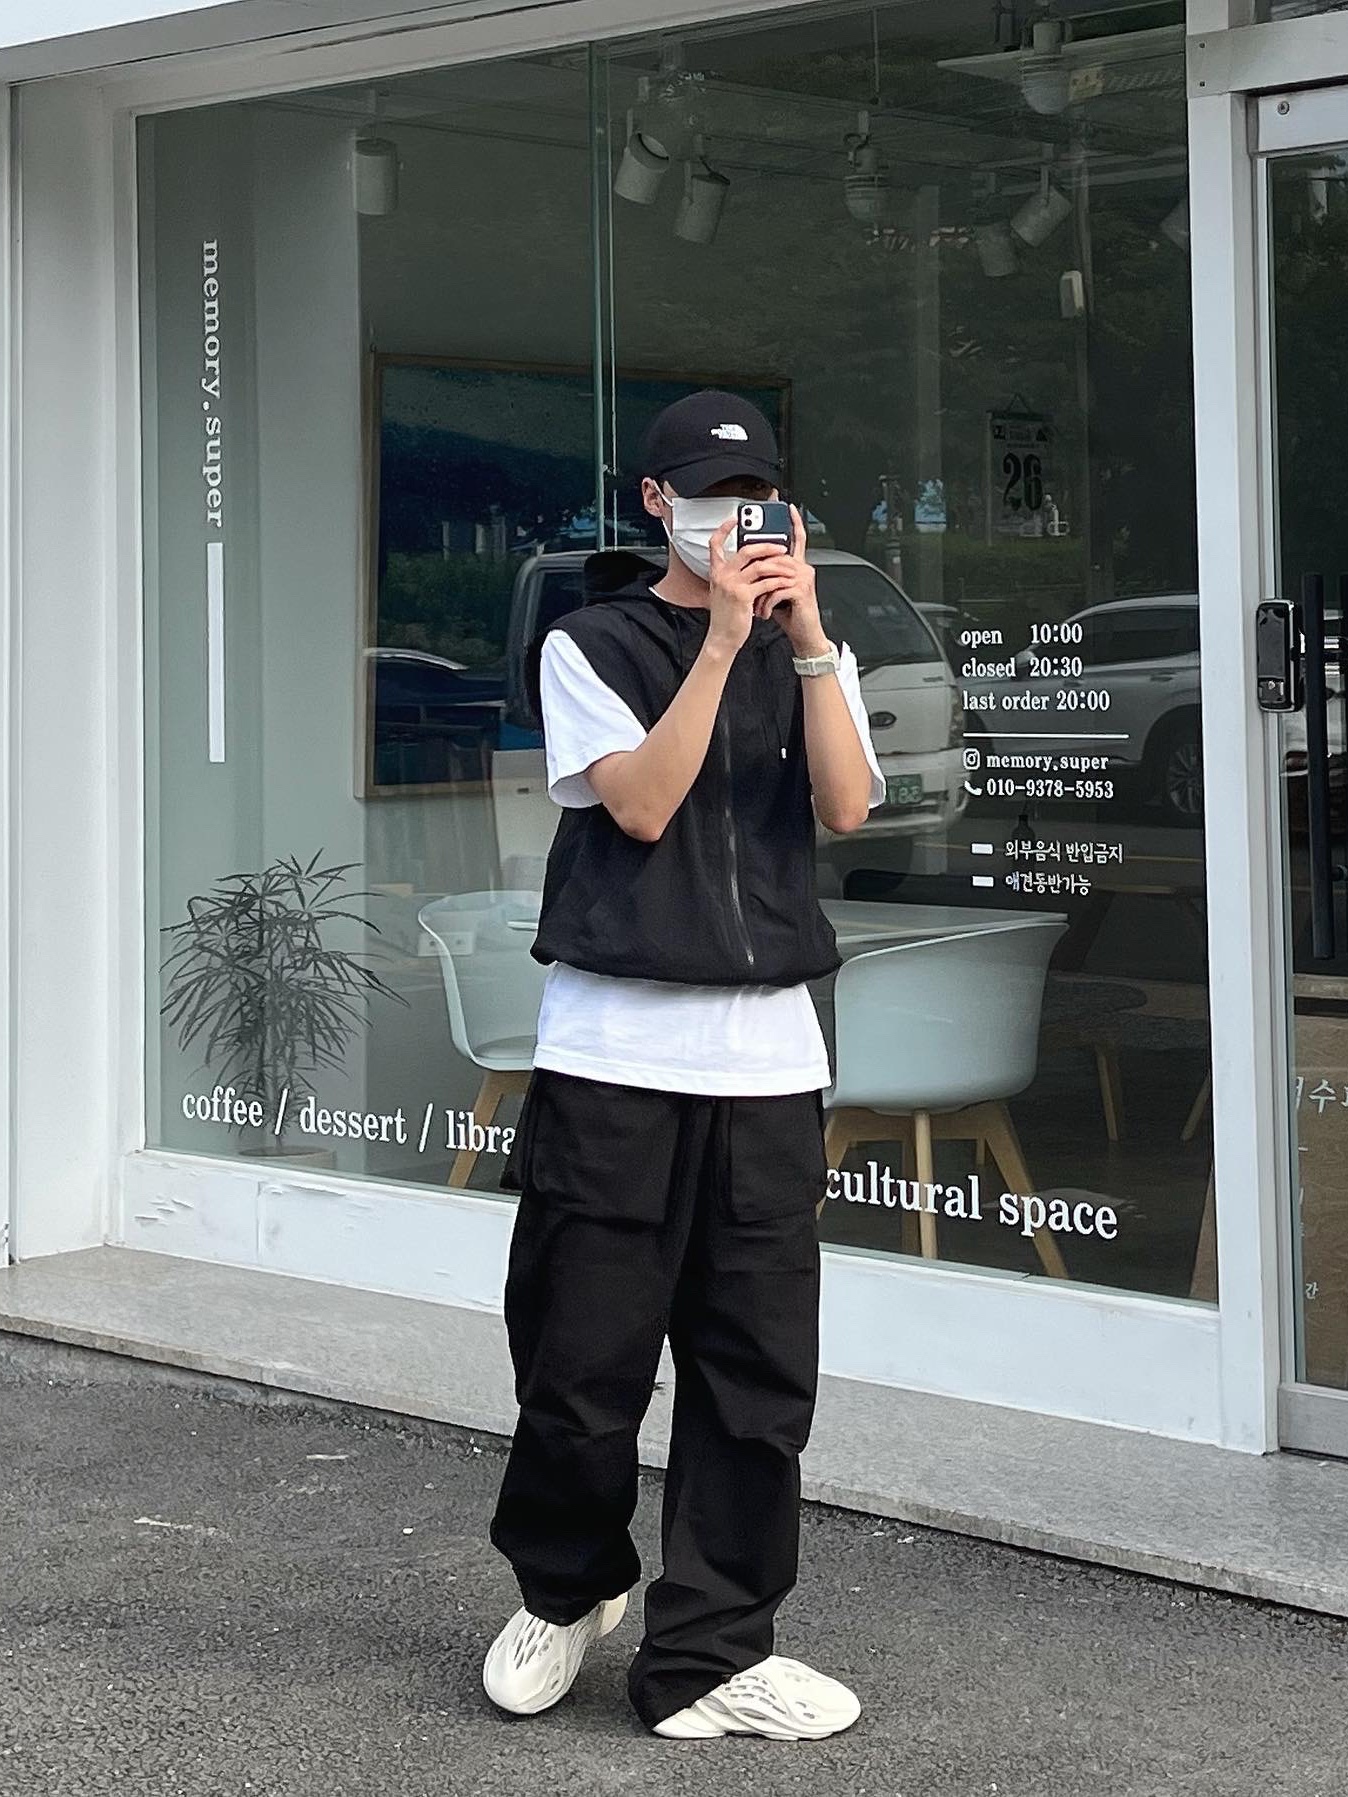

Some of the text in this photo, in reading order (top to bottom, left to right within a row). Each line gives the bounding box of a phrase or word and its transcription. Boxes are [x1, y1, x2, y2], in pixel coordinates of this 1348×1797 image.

[201, 239, 225, 528] memory.super
[1003, 452, 1043, 511] 26
[961, 623, 1084, 648] open 10:00
[961, 655, 1084, 679] closed 20:30
[962, 690, 1111, 712] last order 20:00
[986, 754, 1109, 773] memory.super
[986, 778, 1114, 799] 010-9378-5953
[1005, 839, 1123, 864] 외부음식 반입금지
[1005, 871, 1092, 896] 애견동반가능
[182, 1085, 264, 1127] coffee
[274, 1088, 289, 1136] /
[299, 1096, 408, 1145] dessert
[417, 1102, 434, 1153] /
[826, 1160, 983, 1221] cultural
[998, 1191, 1119, 1240] space
